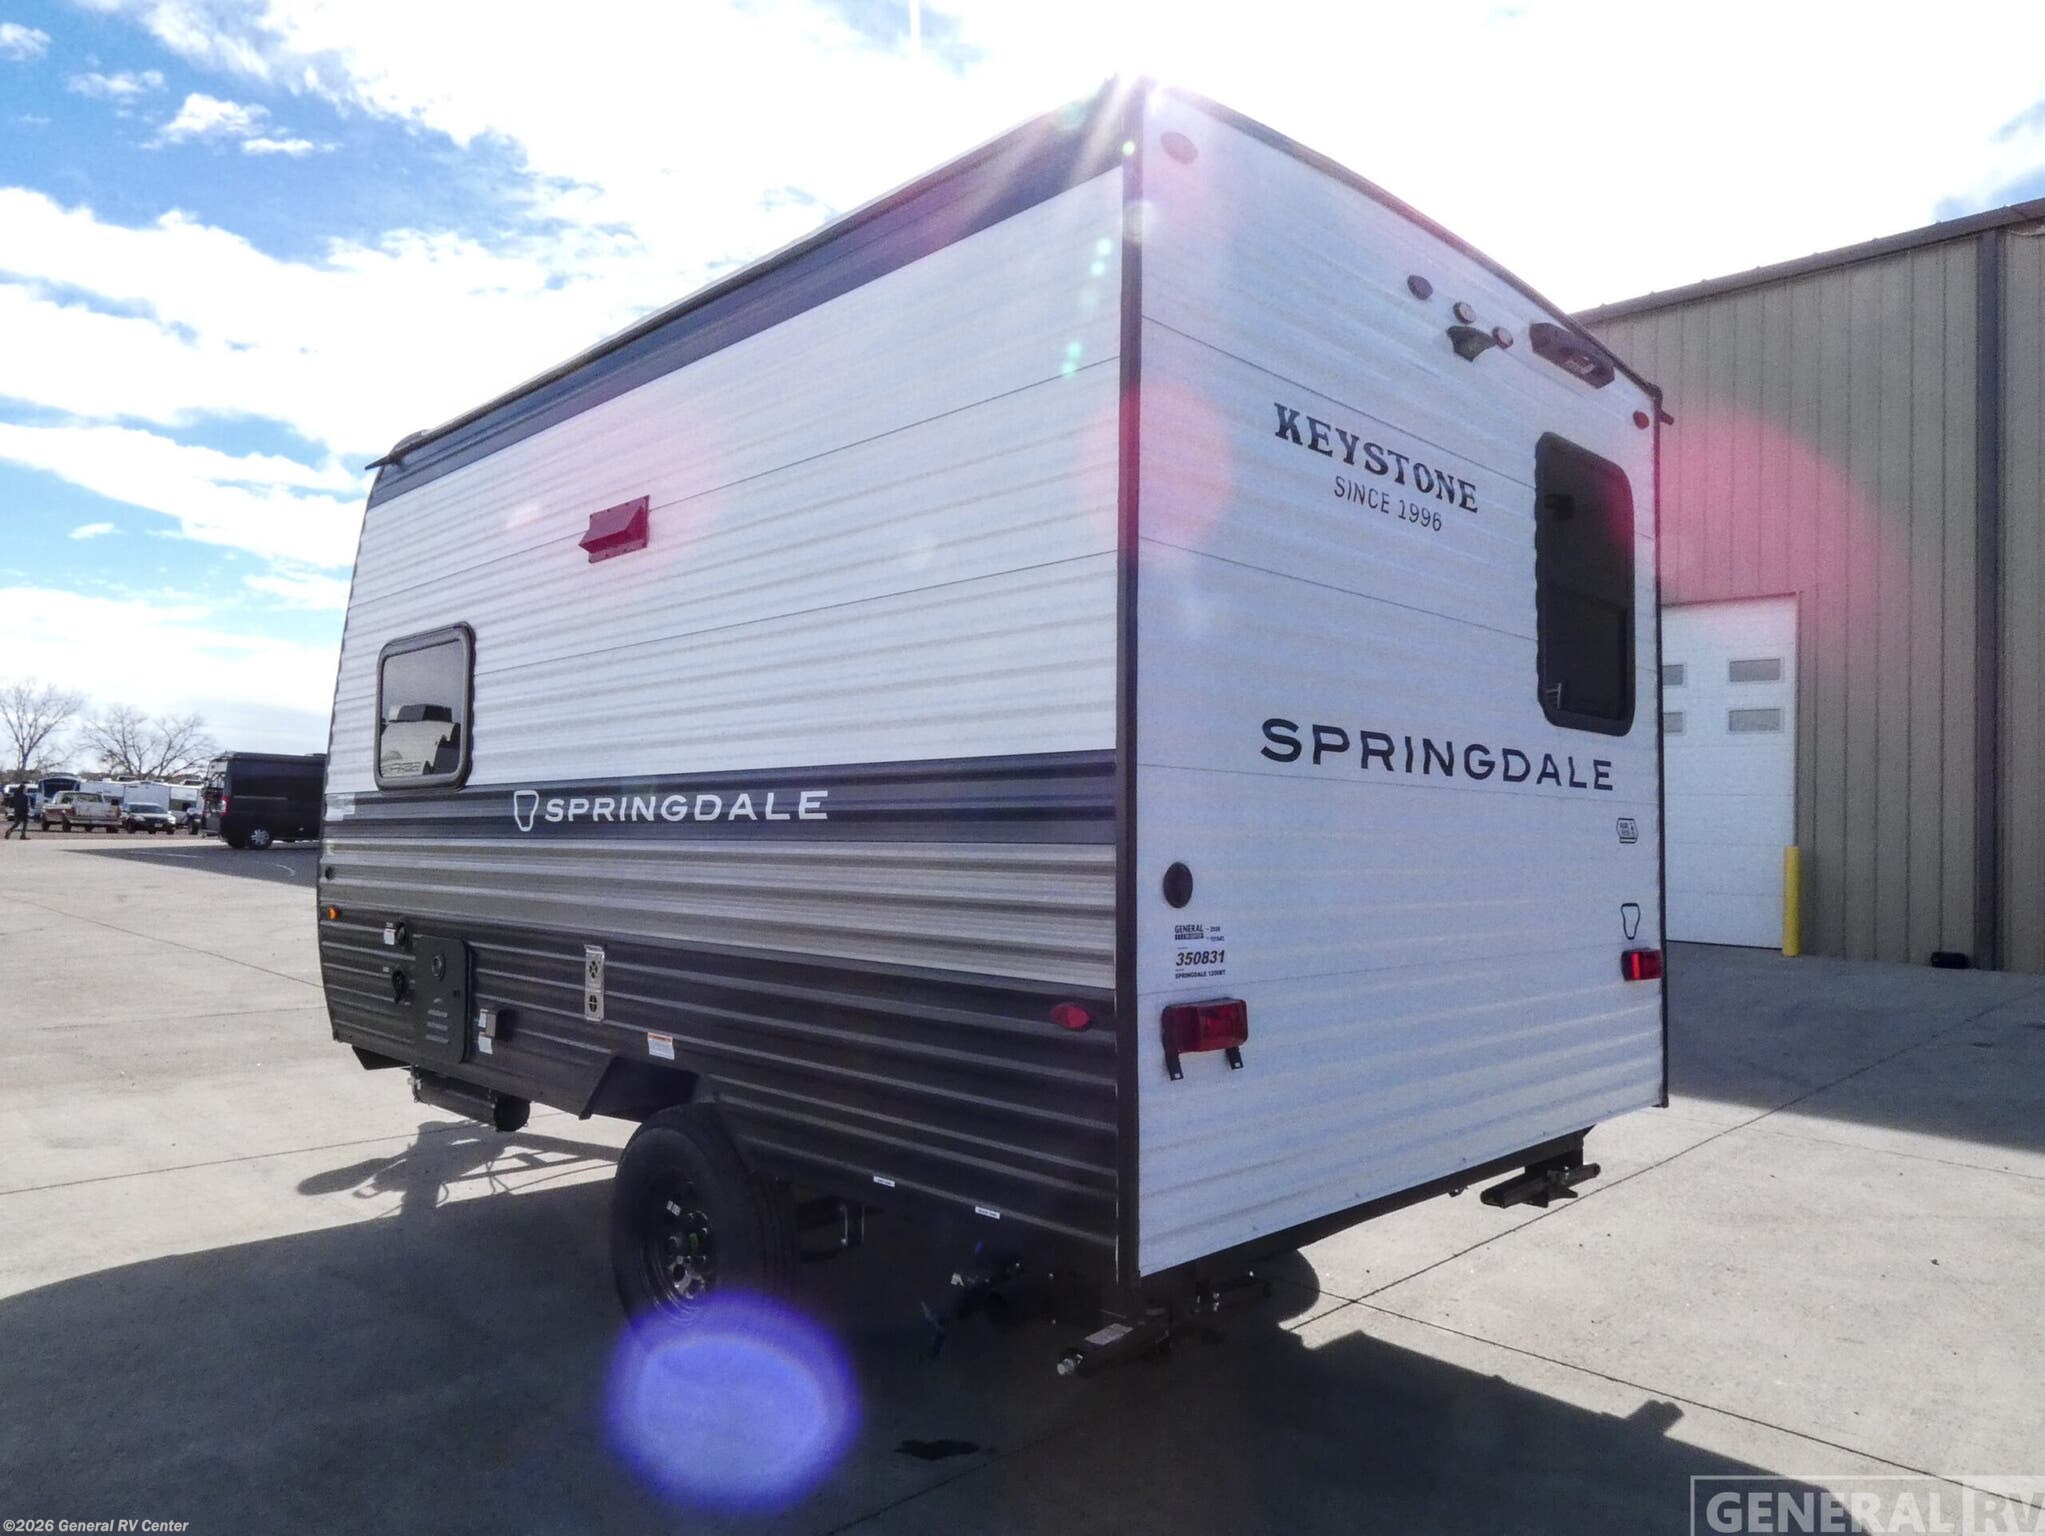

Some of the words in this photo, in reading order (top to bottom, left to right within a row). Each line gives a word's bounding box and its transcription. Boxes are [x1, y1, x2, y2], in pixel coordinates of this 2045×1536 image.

[1274, 402, 1478, 513] KEYSTONE
[1334, 475, 1390, 514] SINCE
[1398, 499, 1442, 532] 1996
[1260, 718, 1614, 791] SPRINGDALE
[544, 790, 828, 822] SPRINGDALE
[1174, 924, 1203, 933] GENERAL
[1176, 950, 1225, 966] 350831
